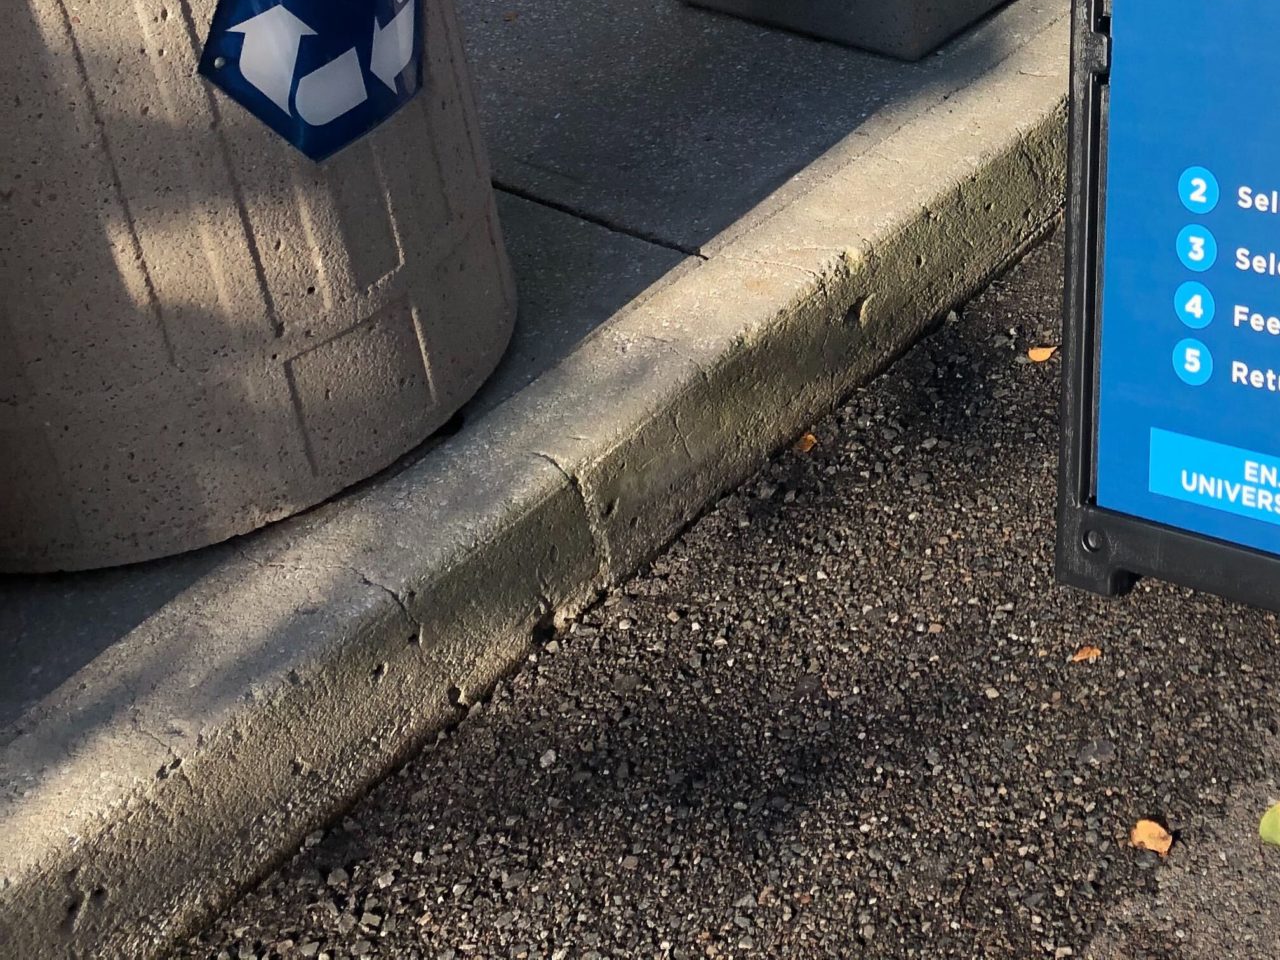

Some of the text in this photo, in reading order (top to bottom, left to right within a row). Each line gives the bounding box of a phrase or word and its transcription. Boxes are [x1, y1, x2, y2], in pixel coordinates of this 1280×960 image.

[1190, 178, 1207, 203] 2
[1189, 236, 1204, 261] 3
[1185, 295, 1203, 318] 4
[1184, 348, 1201, 372] 5
